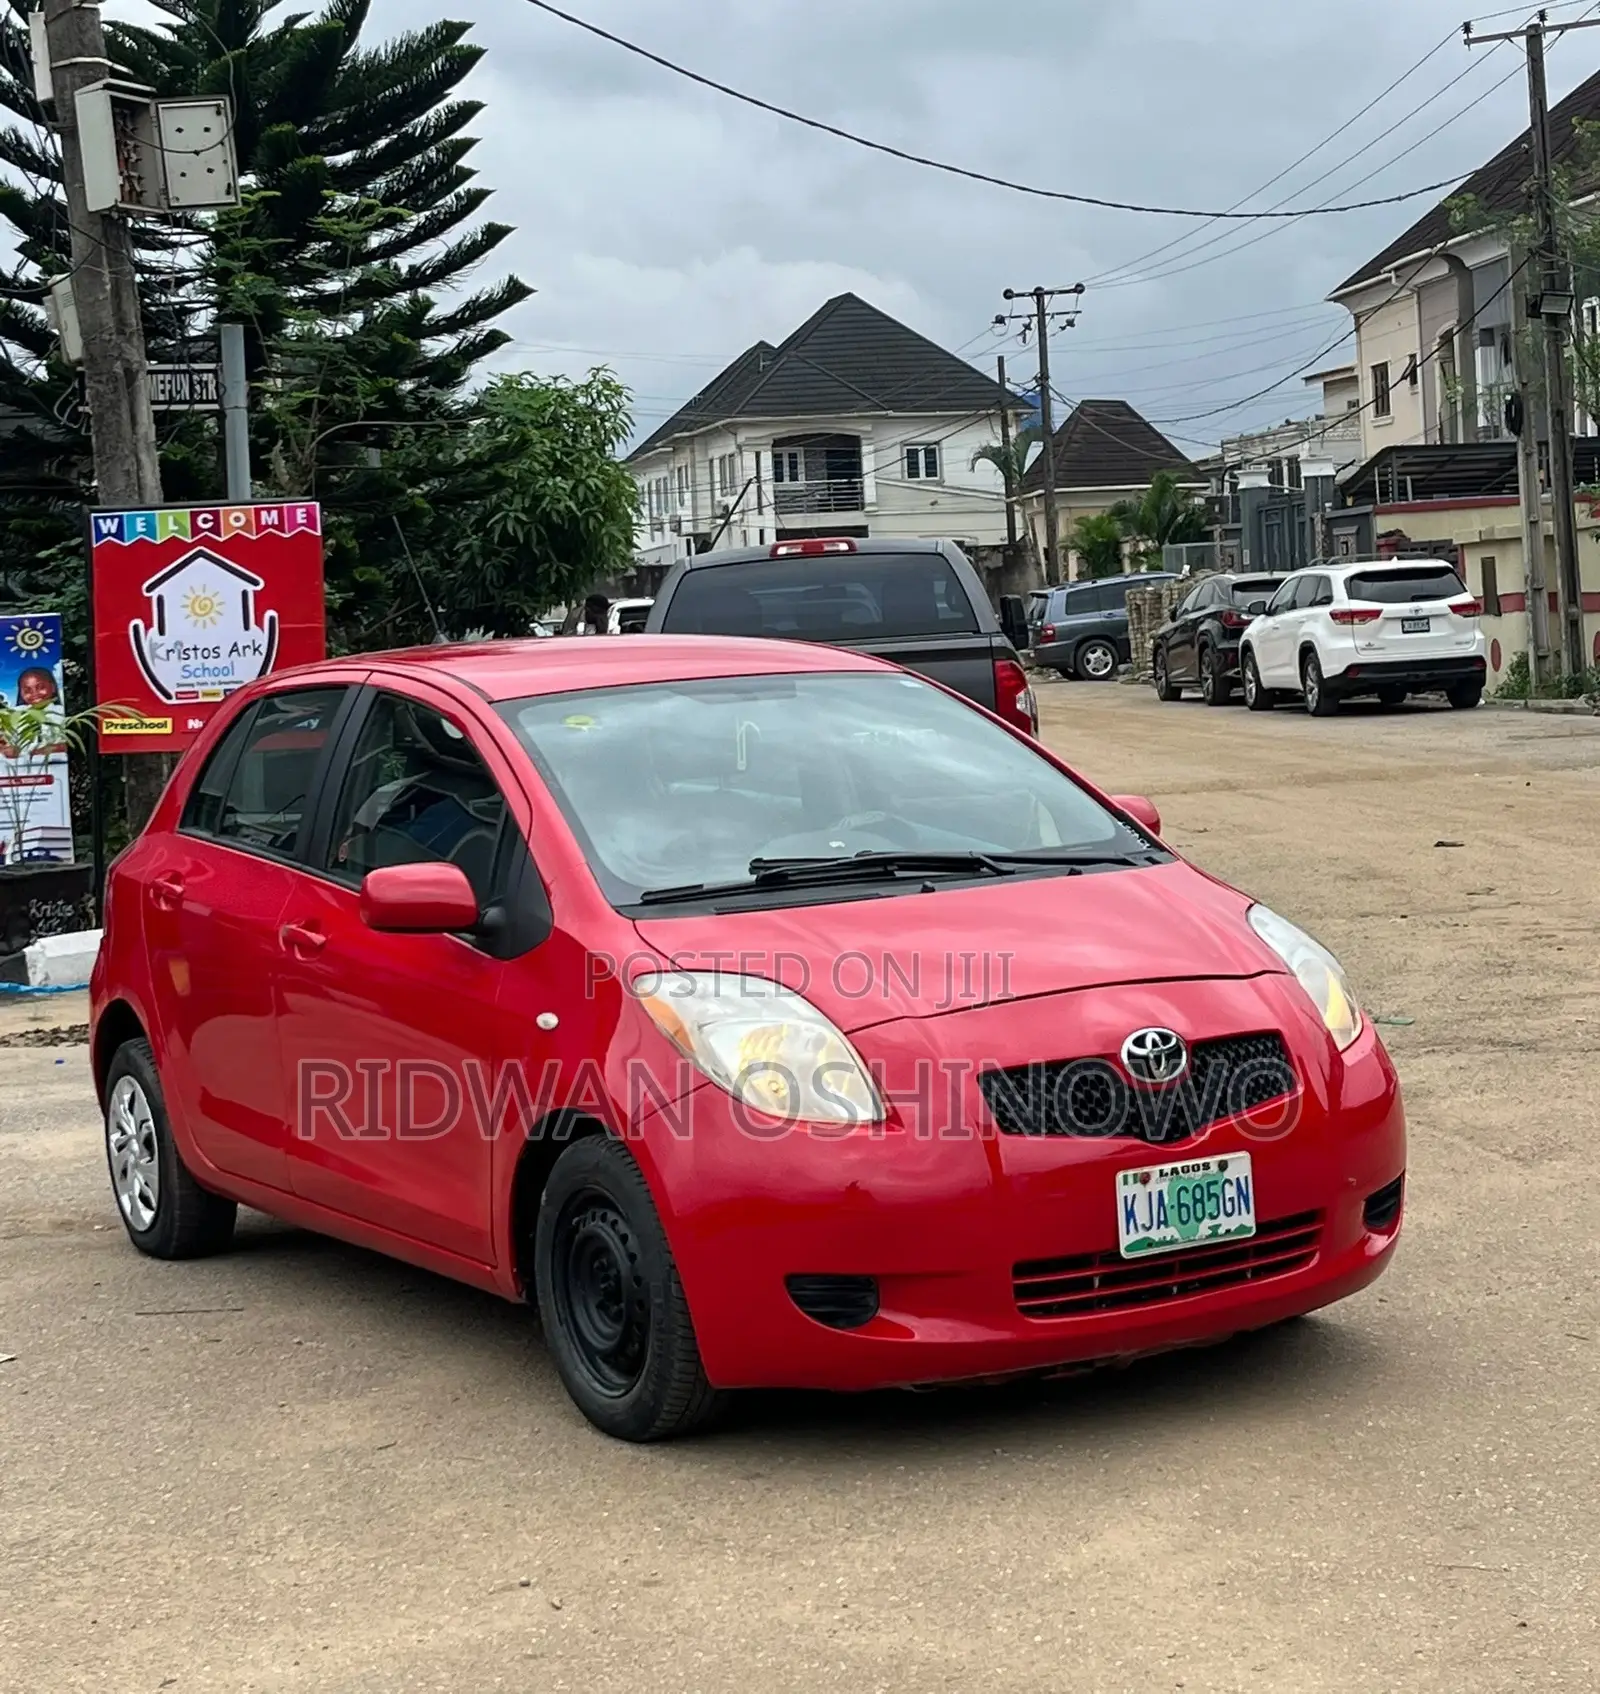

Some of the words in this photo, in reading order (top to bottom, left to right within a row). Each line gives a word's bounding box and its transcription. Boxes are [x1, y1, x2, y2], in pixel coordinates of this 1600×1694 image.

[98, 508, 308, 535] WELCOME
[149, 638, 221, 667] Kristos
[228, 638, 264, 658] Ark
[181, 660, 235, 679] School
[104, 720, 168, 730] Preschool
[1158, 1162, 1211, 1178] LAGOS
